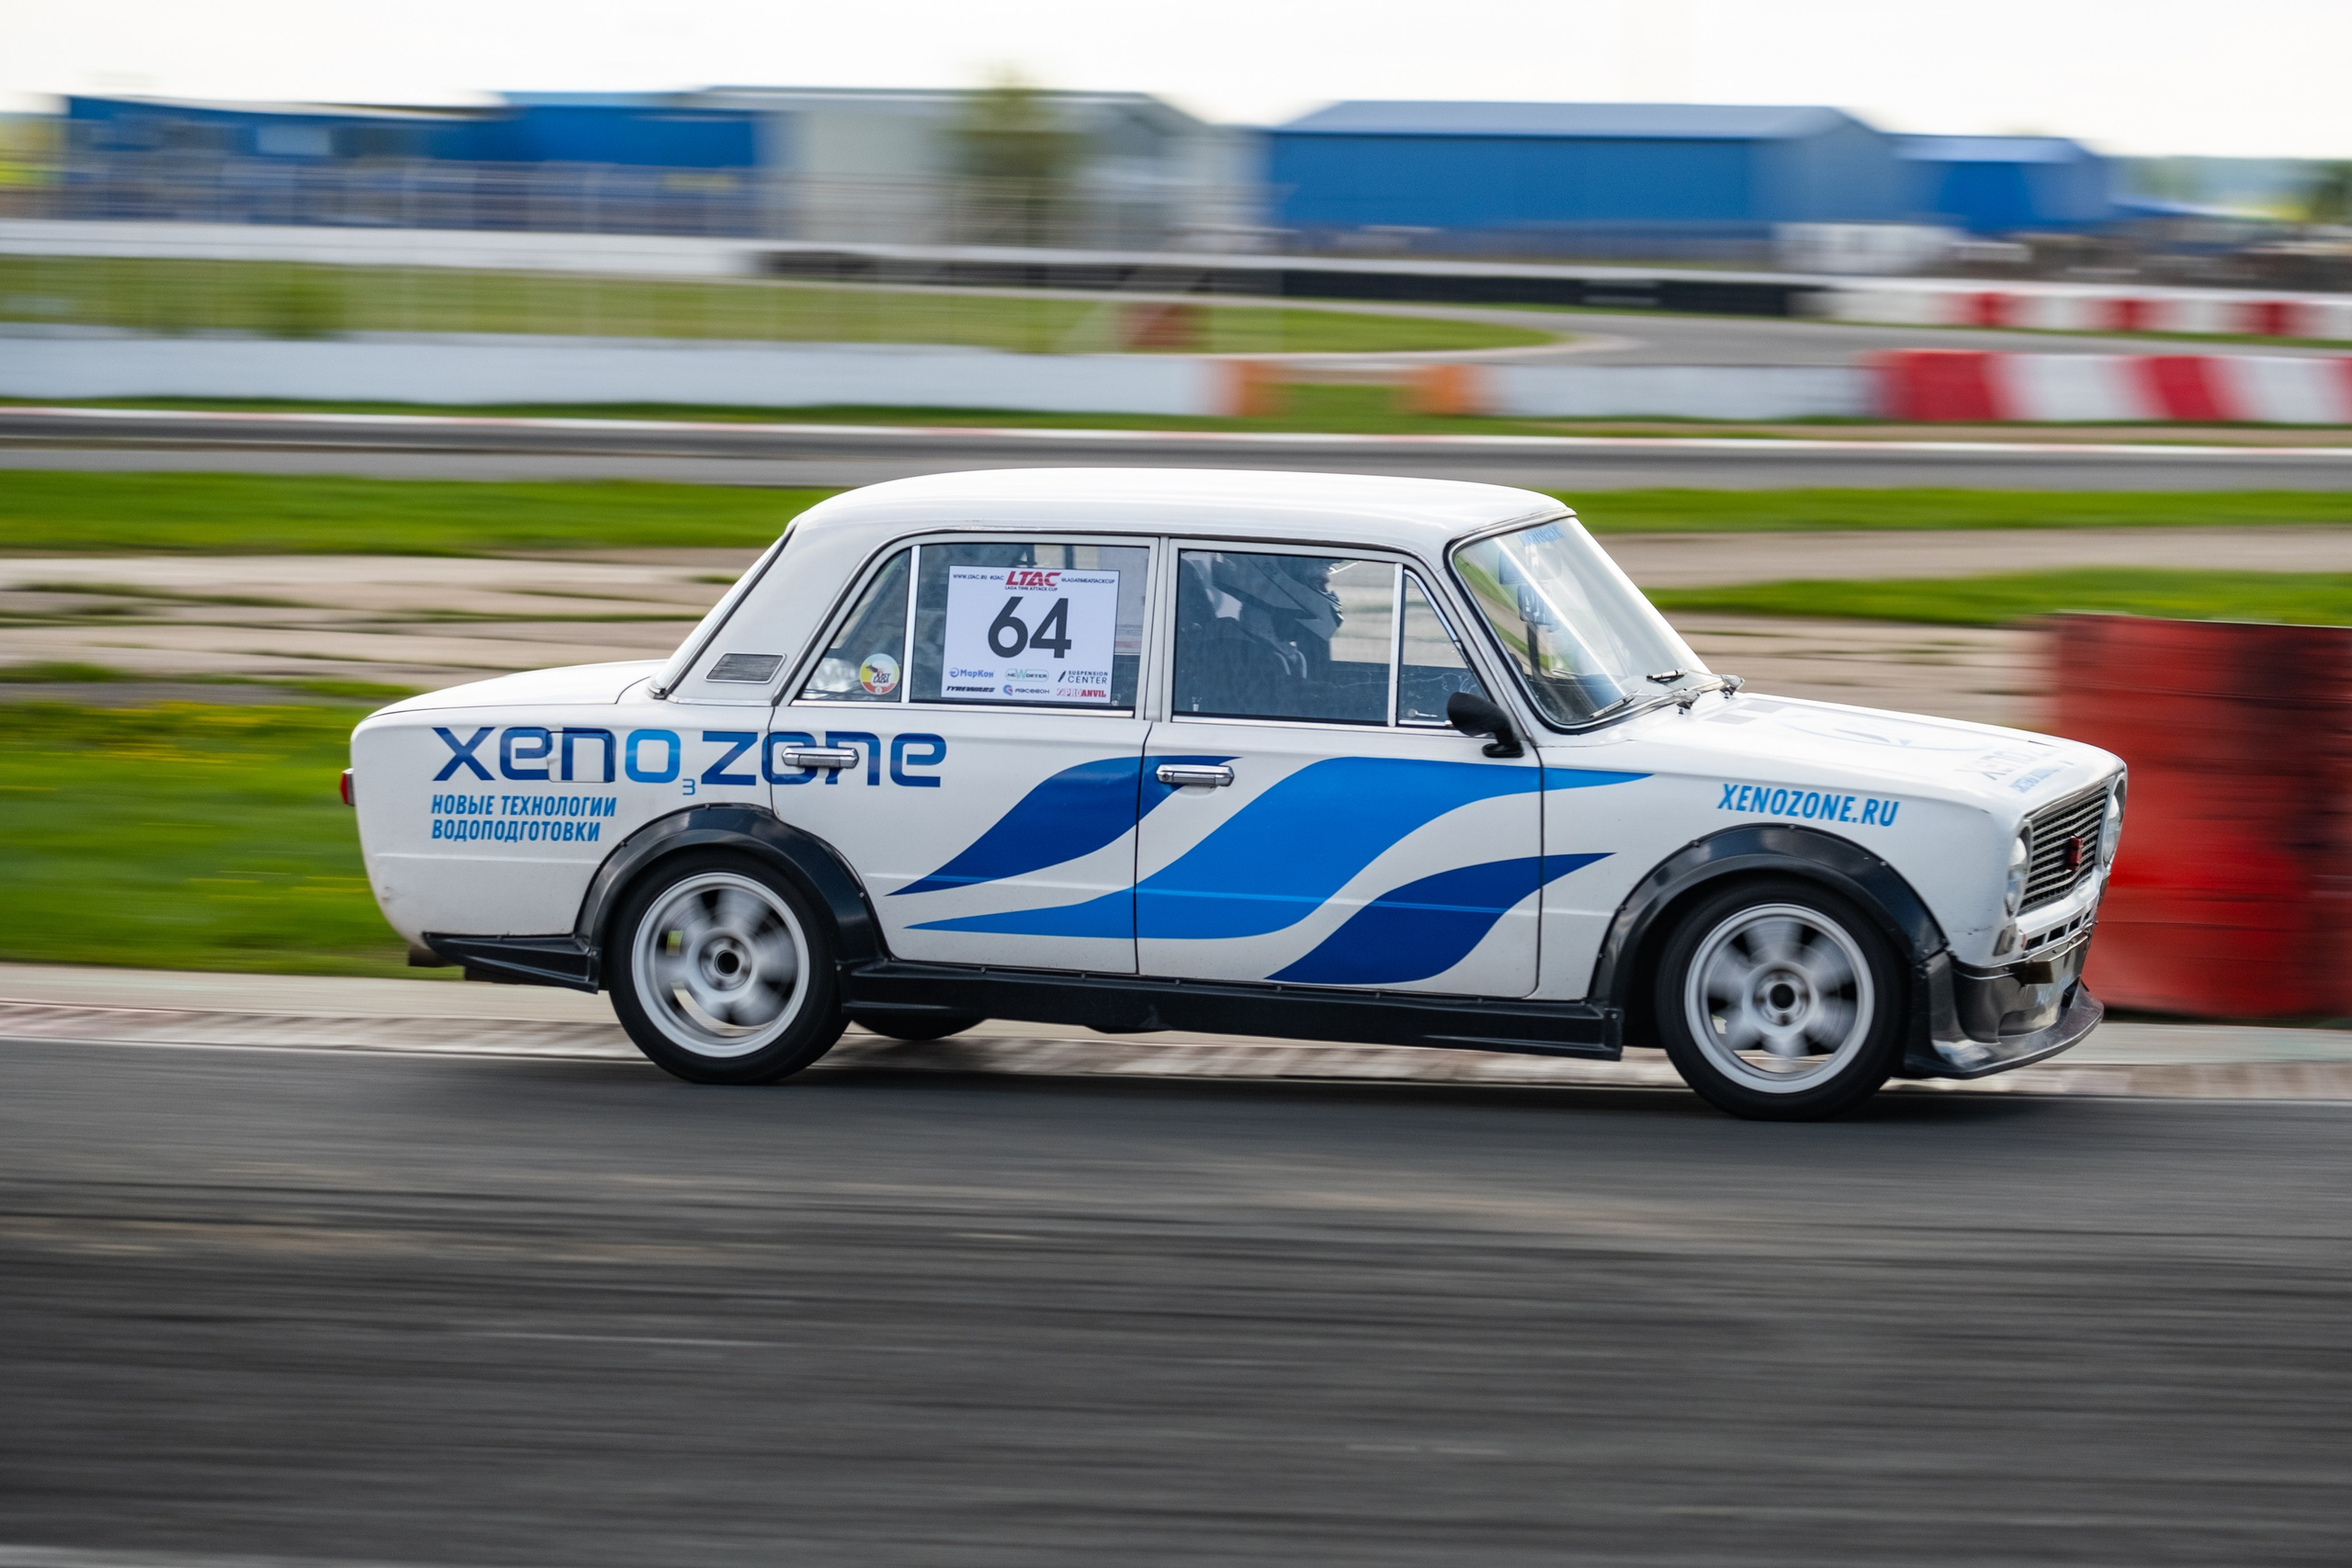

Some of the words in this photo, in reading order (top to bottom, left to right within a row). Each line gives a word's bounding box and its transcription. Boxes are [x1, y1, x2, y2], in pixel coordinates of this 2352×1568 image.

[1006, 571, 1062, 586] LTAC
[988, 596, 1072, 659] 64
[1068, 675, 1107, 684] CENTER
[431, 795, 495, 816] НОВЫЕ
[501, 795, 617, 818] ТЕХНОЛОГИИ
[1717, 783, 1900, 828] XENOZONE.RU
[431, 819, 601, 843] ВОДОПОДГОТОВКИ
